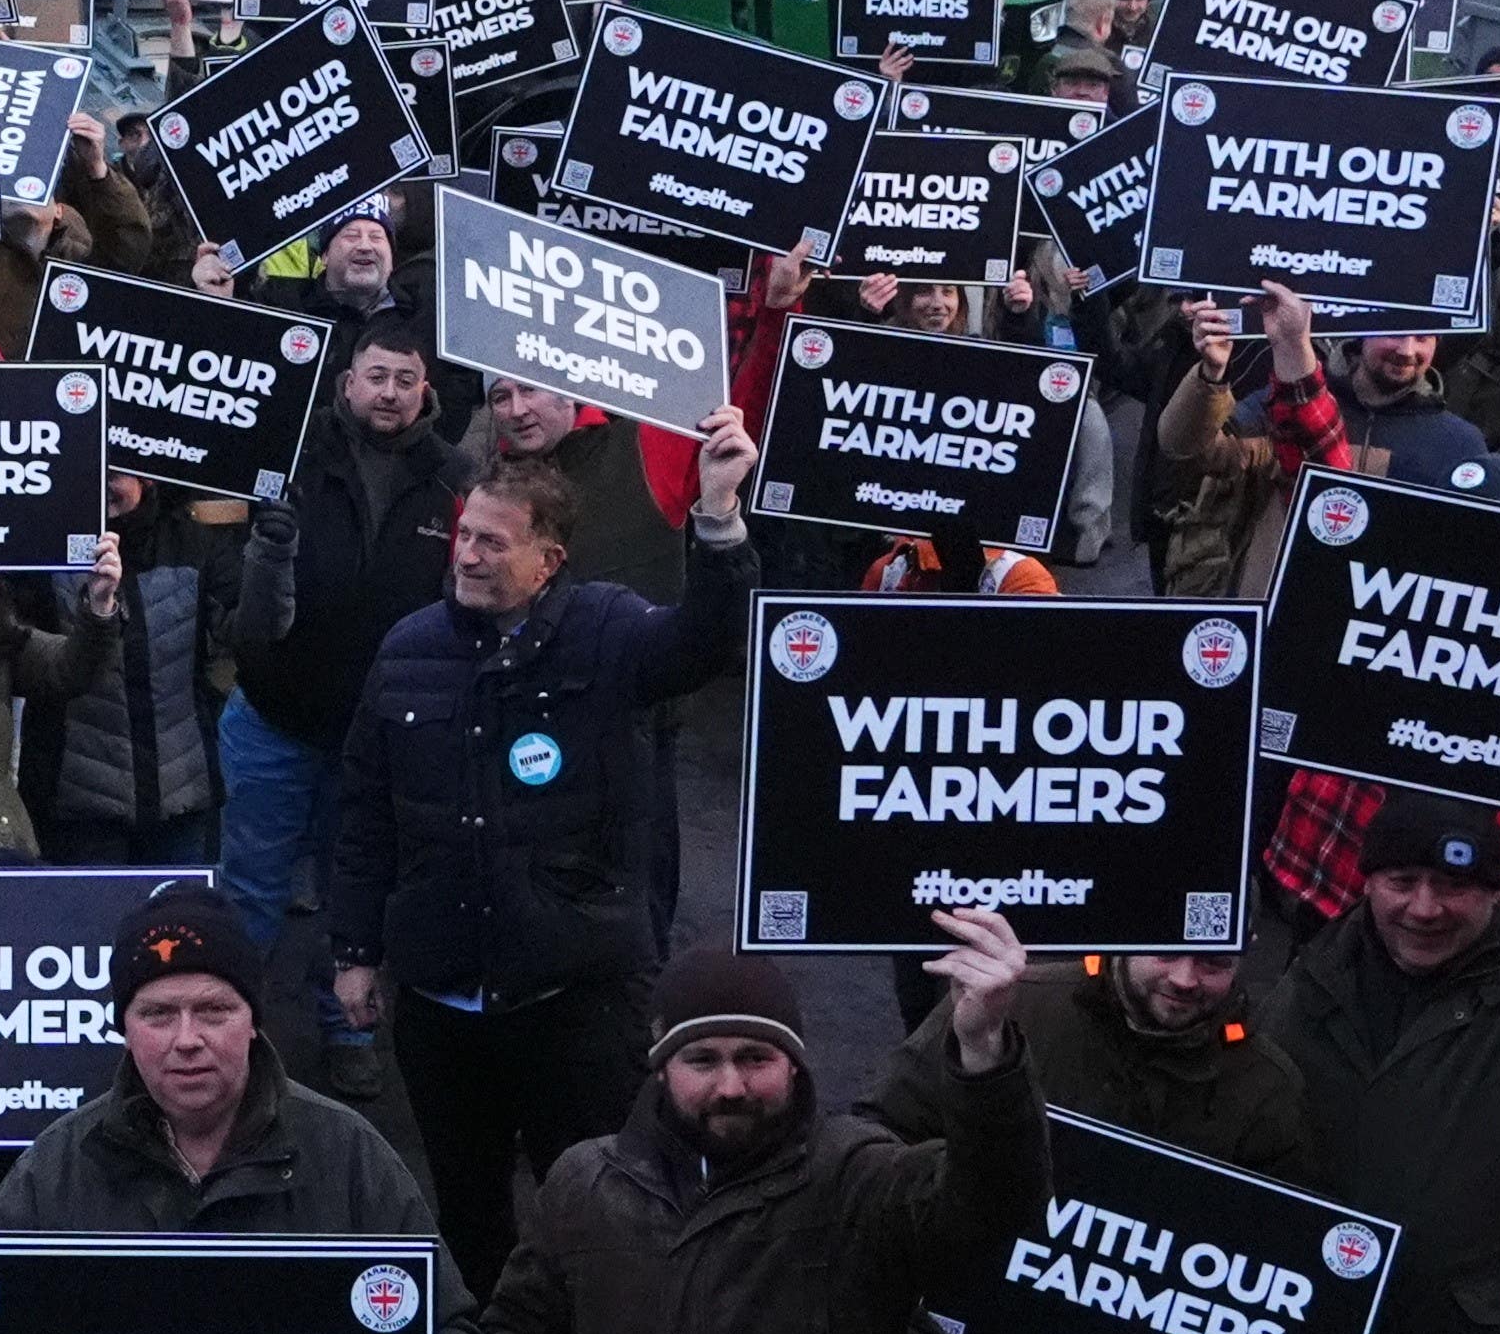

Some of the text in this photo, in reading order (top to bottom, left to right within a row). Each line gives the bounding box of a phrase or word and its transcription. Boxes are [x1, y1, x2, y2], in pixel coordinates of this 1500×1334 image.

[1196, 17, 1358, 83] FARMERS
[1293, 17, 1367, 57] OUR
[195, 59, 352, 169] WITH OUR
[629, 66, 827, 151] WITH OUR
[218, 96, 360, 200] FARMERS
[619, 110, 808, 186] FARMERS
[1206, 135, 1444, 189] WITH OUR
[273, 164, 349, 219] #together
[649, 173, 753, 216] #together
[1207, 177, 1427, 229] FARMERS
[510, 231, 660, 313] NO TO
[1250, 245, 1372, 275] #together
[465, 258, 705, 370] NET ZERO
[77, 322, 276, 395] WITH OUR
[516, 331, 658, 399] #together
[822, 378, 1035, 438] WITH OUR
[819, 418, 1018, 473] FARMERS
[855, 482, 965, 514] #together
[828, 696, 1184, 755] WITH OUR
[839, 765, 1165, 823] FARMERS
[912, 870, 1093, 911] #together
[1181, 1243, 1312, 1321] OUR
